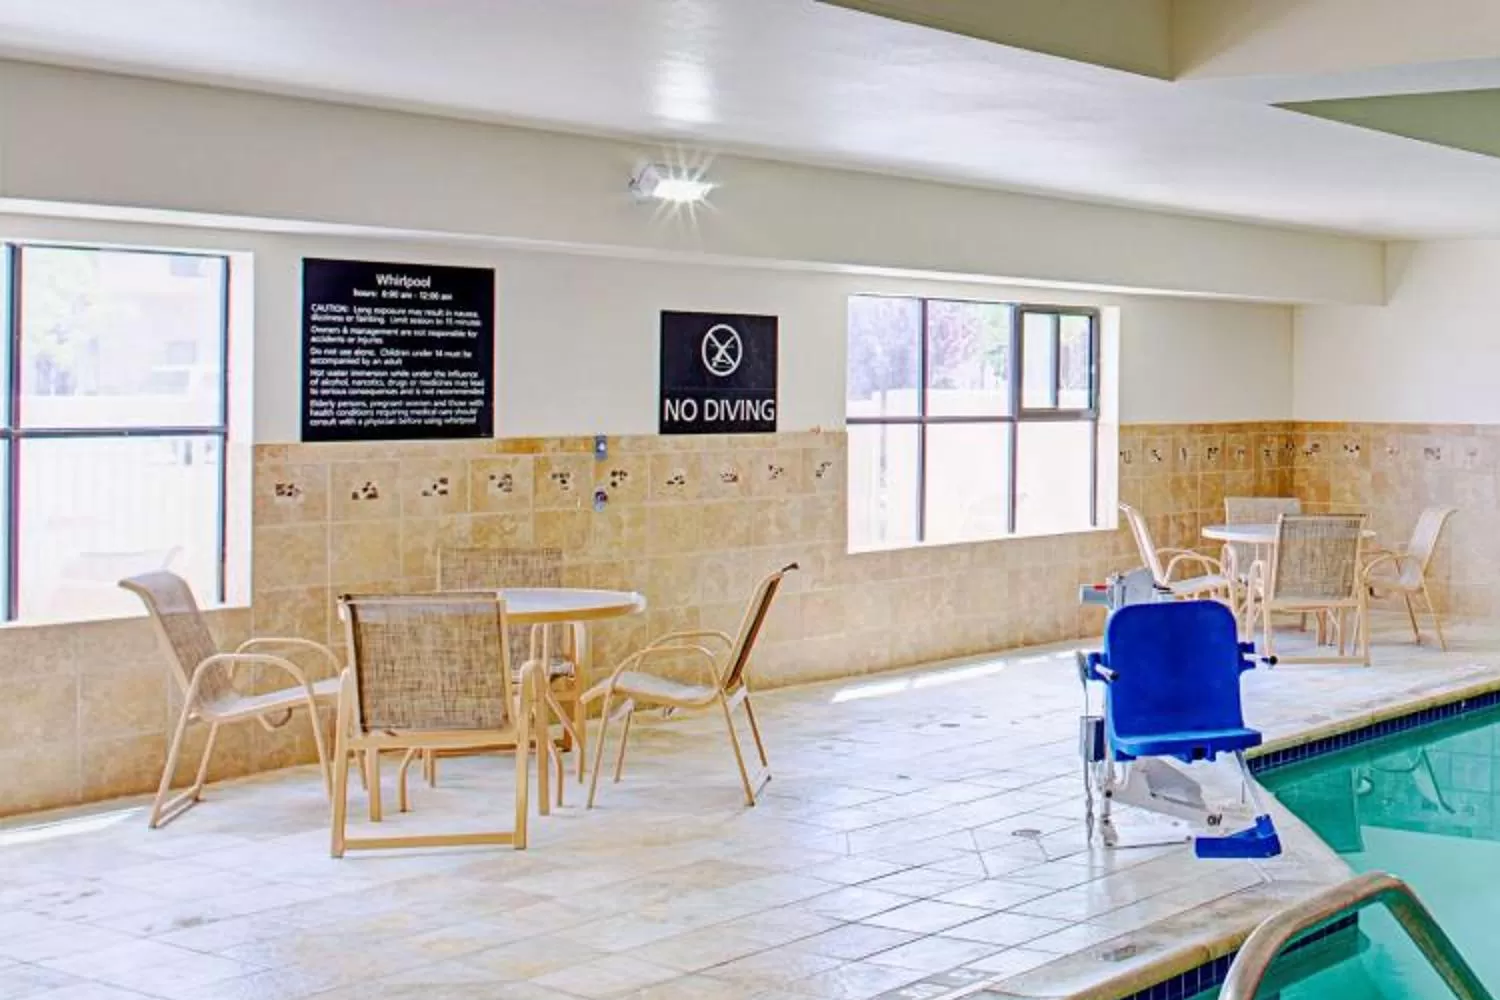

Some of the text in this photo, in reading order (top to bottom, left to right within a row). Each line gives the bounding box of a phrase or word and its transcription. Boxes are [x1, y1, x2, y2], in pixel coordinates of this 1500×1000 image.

[376, 273, 431, 288] Whirlpool
[311, 303, 349, 312] CAUTION:
[350, 327, 398, 337] management
[664, 399, 775, 421] NO DIVING
